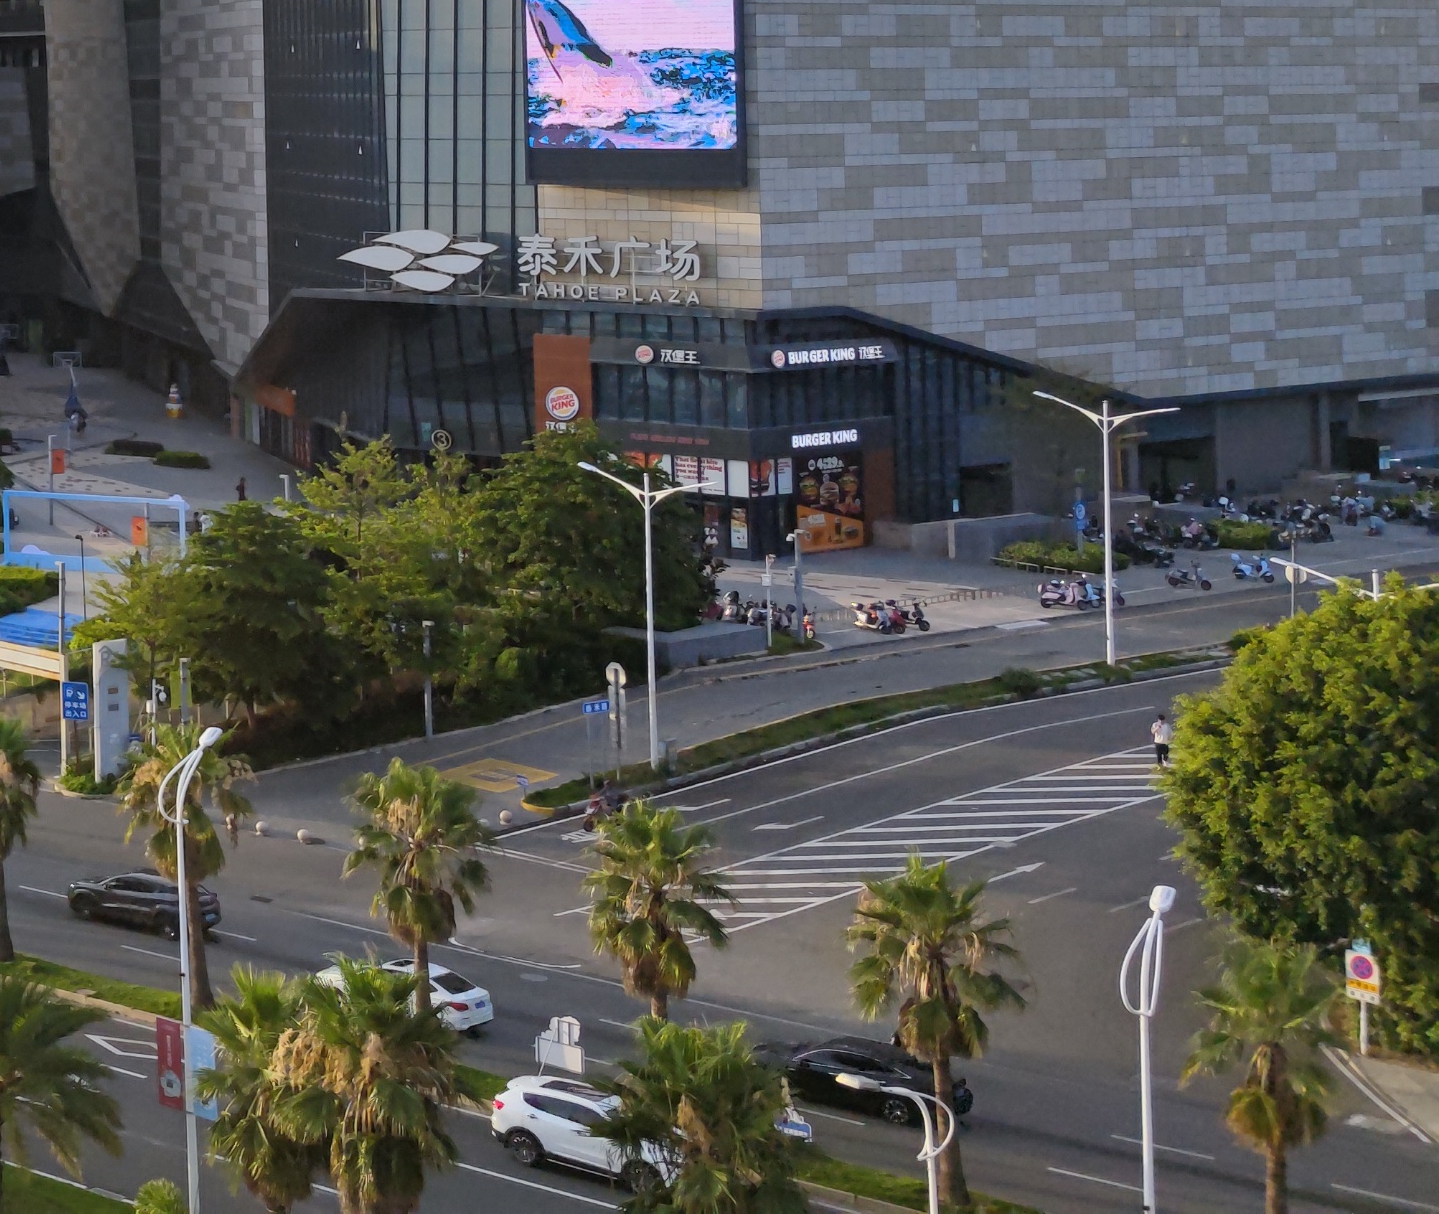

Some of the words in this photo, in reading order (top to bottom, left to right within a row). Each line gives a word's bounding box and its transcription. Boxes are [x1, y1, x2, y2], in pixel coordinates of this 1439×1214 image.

[517, 233, 701, 281] 泰禾广场
[518, 283, 599, 301] TAHOE
[615, 287, 700, 305] PLAZA
[660, 349, 700, 364] 汉堡王
[788, 349, 829, 364] BURGER
[830, 347, 855, 362] KING
[550, 394, 574, 404] BURGER
[551, 399, 575, 412] KING
[436, 432, 447, 447] 3
[791, 432, 831, 448] BURGER
[832, 429, 857, 445] KING
